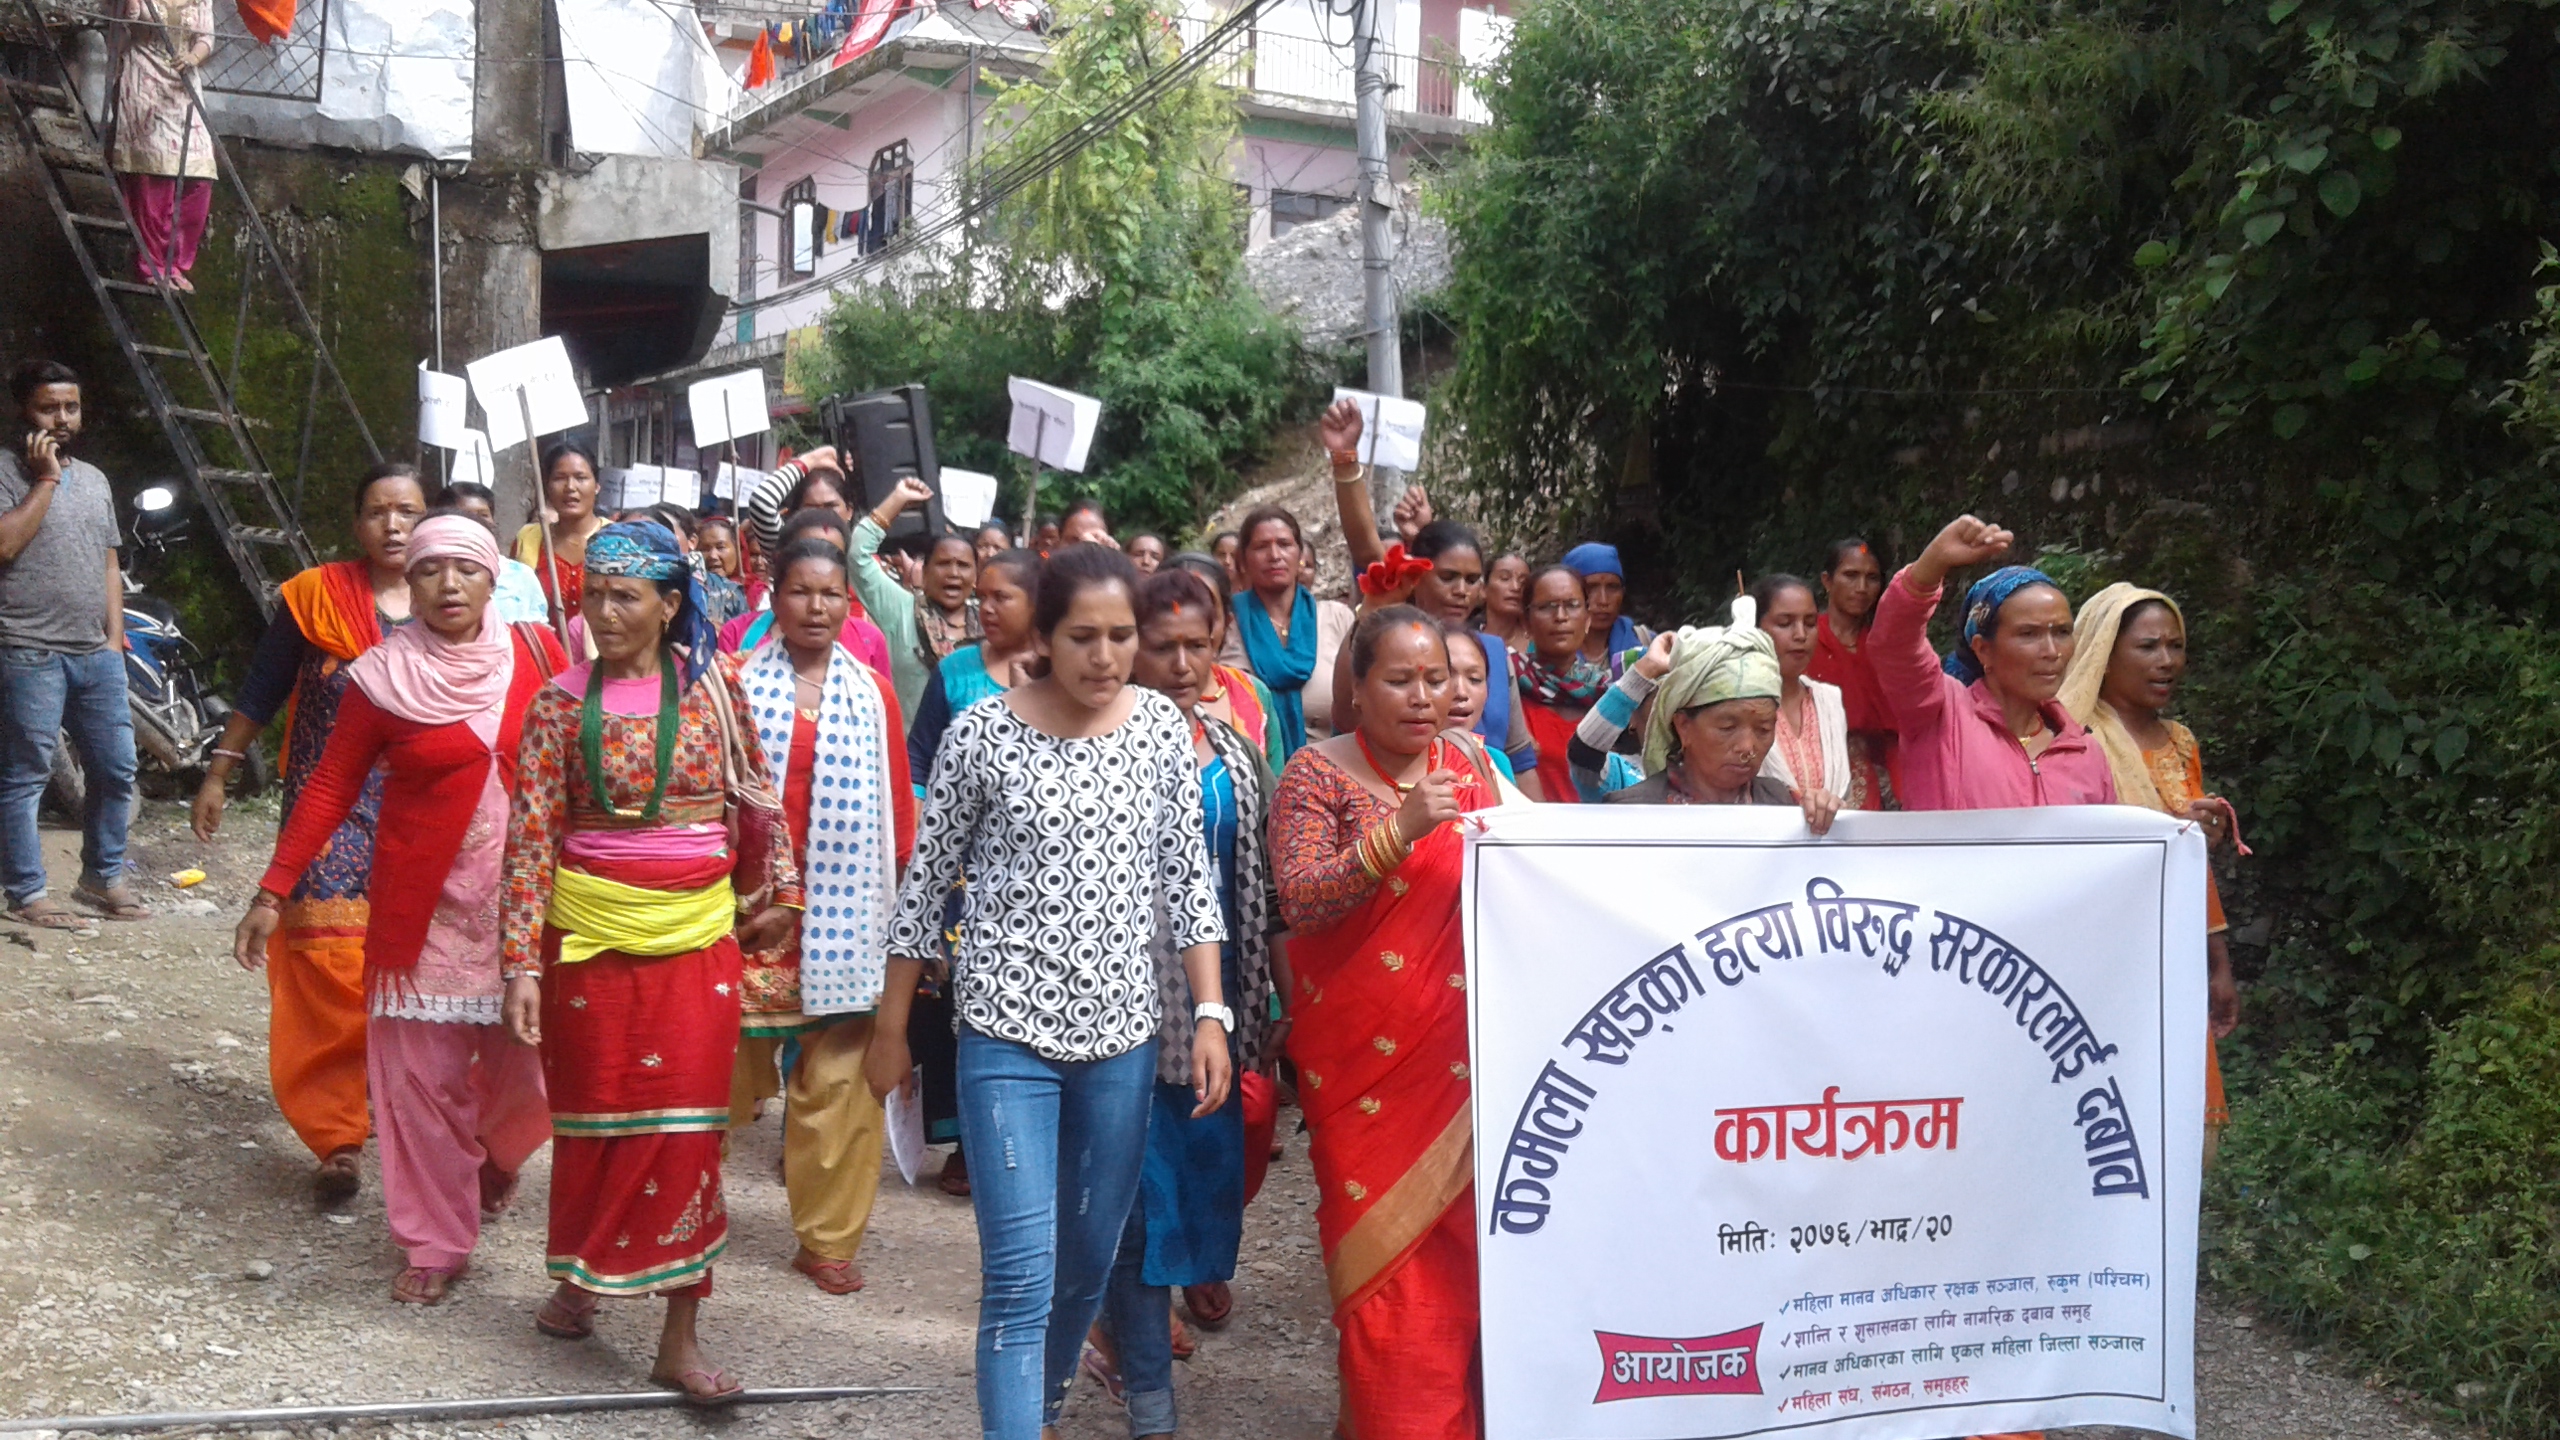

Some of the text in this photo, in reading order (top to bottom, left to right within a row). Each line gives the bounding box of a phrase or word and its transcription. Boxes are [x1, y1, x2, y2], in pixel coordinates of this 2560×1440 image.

[1489, 1058, 1597, 1235] कमला
[1694, 902, 1803, 986] हत्या
[1929, 910, 2119, 1084] सरकारलाई
[2073, 1075, 2150, 1199] दबाव
[1714, 1086, 1964, 1163] कार्यक्रम
[1793, 1292, 1834, 1314] महिला
[1839, 1290, 1875, 1306] मानव
[1881, 1282, 1938, 1303] अधिकार
[1943, 1281, 1980, 1299] रक्षक
[2047, 1274, 2081, 1293] रुकुम
[2089, 1267, 2150, 1290] (पश्चिम)
[1794, 1324, 1832, 1348] शान्ति
[1838, 1326, 1848, 1342] र
[1924, 1309, 1957, 1331] लागि
[1963, 1306, 2015, 1326] नागरिक
[2022, 1306, 2055, 1324] दबाव
[2061, 1304, 2092, 1323] समुह
[1612, 1342, 1751, 1384] आयोजक
[1793, 1332, 2146, 1379] मानव अधिकारका लागि एकल महिला जिल्ला सञ्जाल
[1791, 1390, 1832, 1412] महिला
